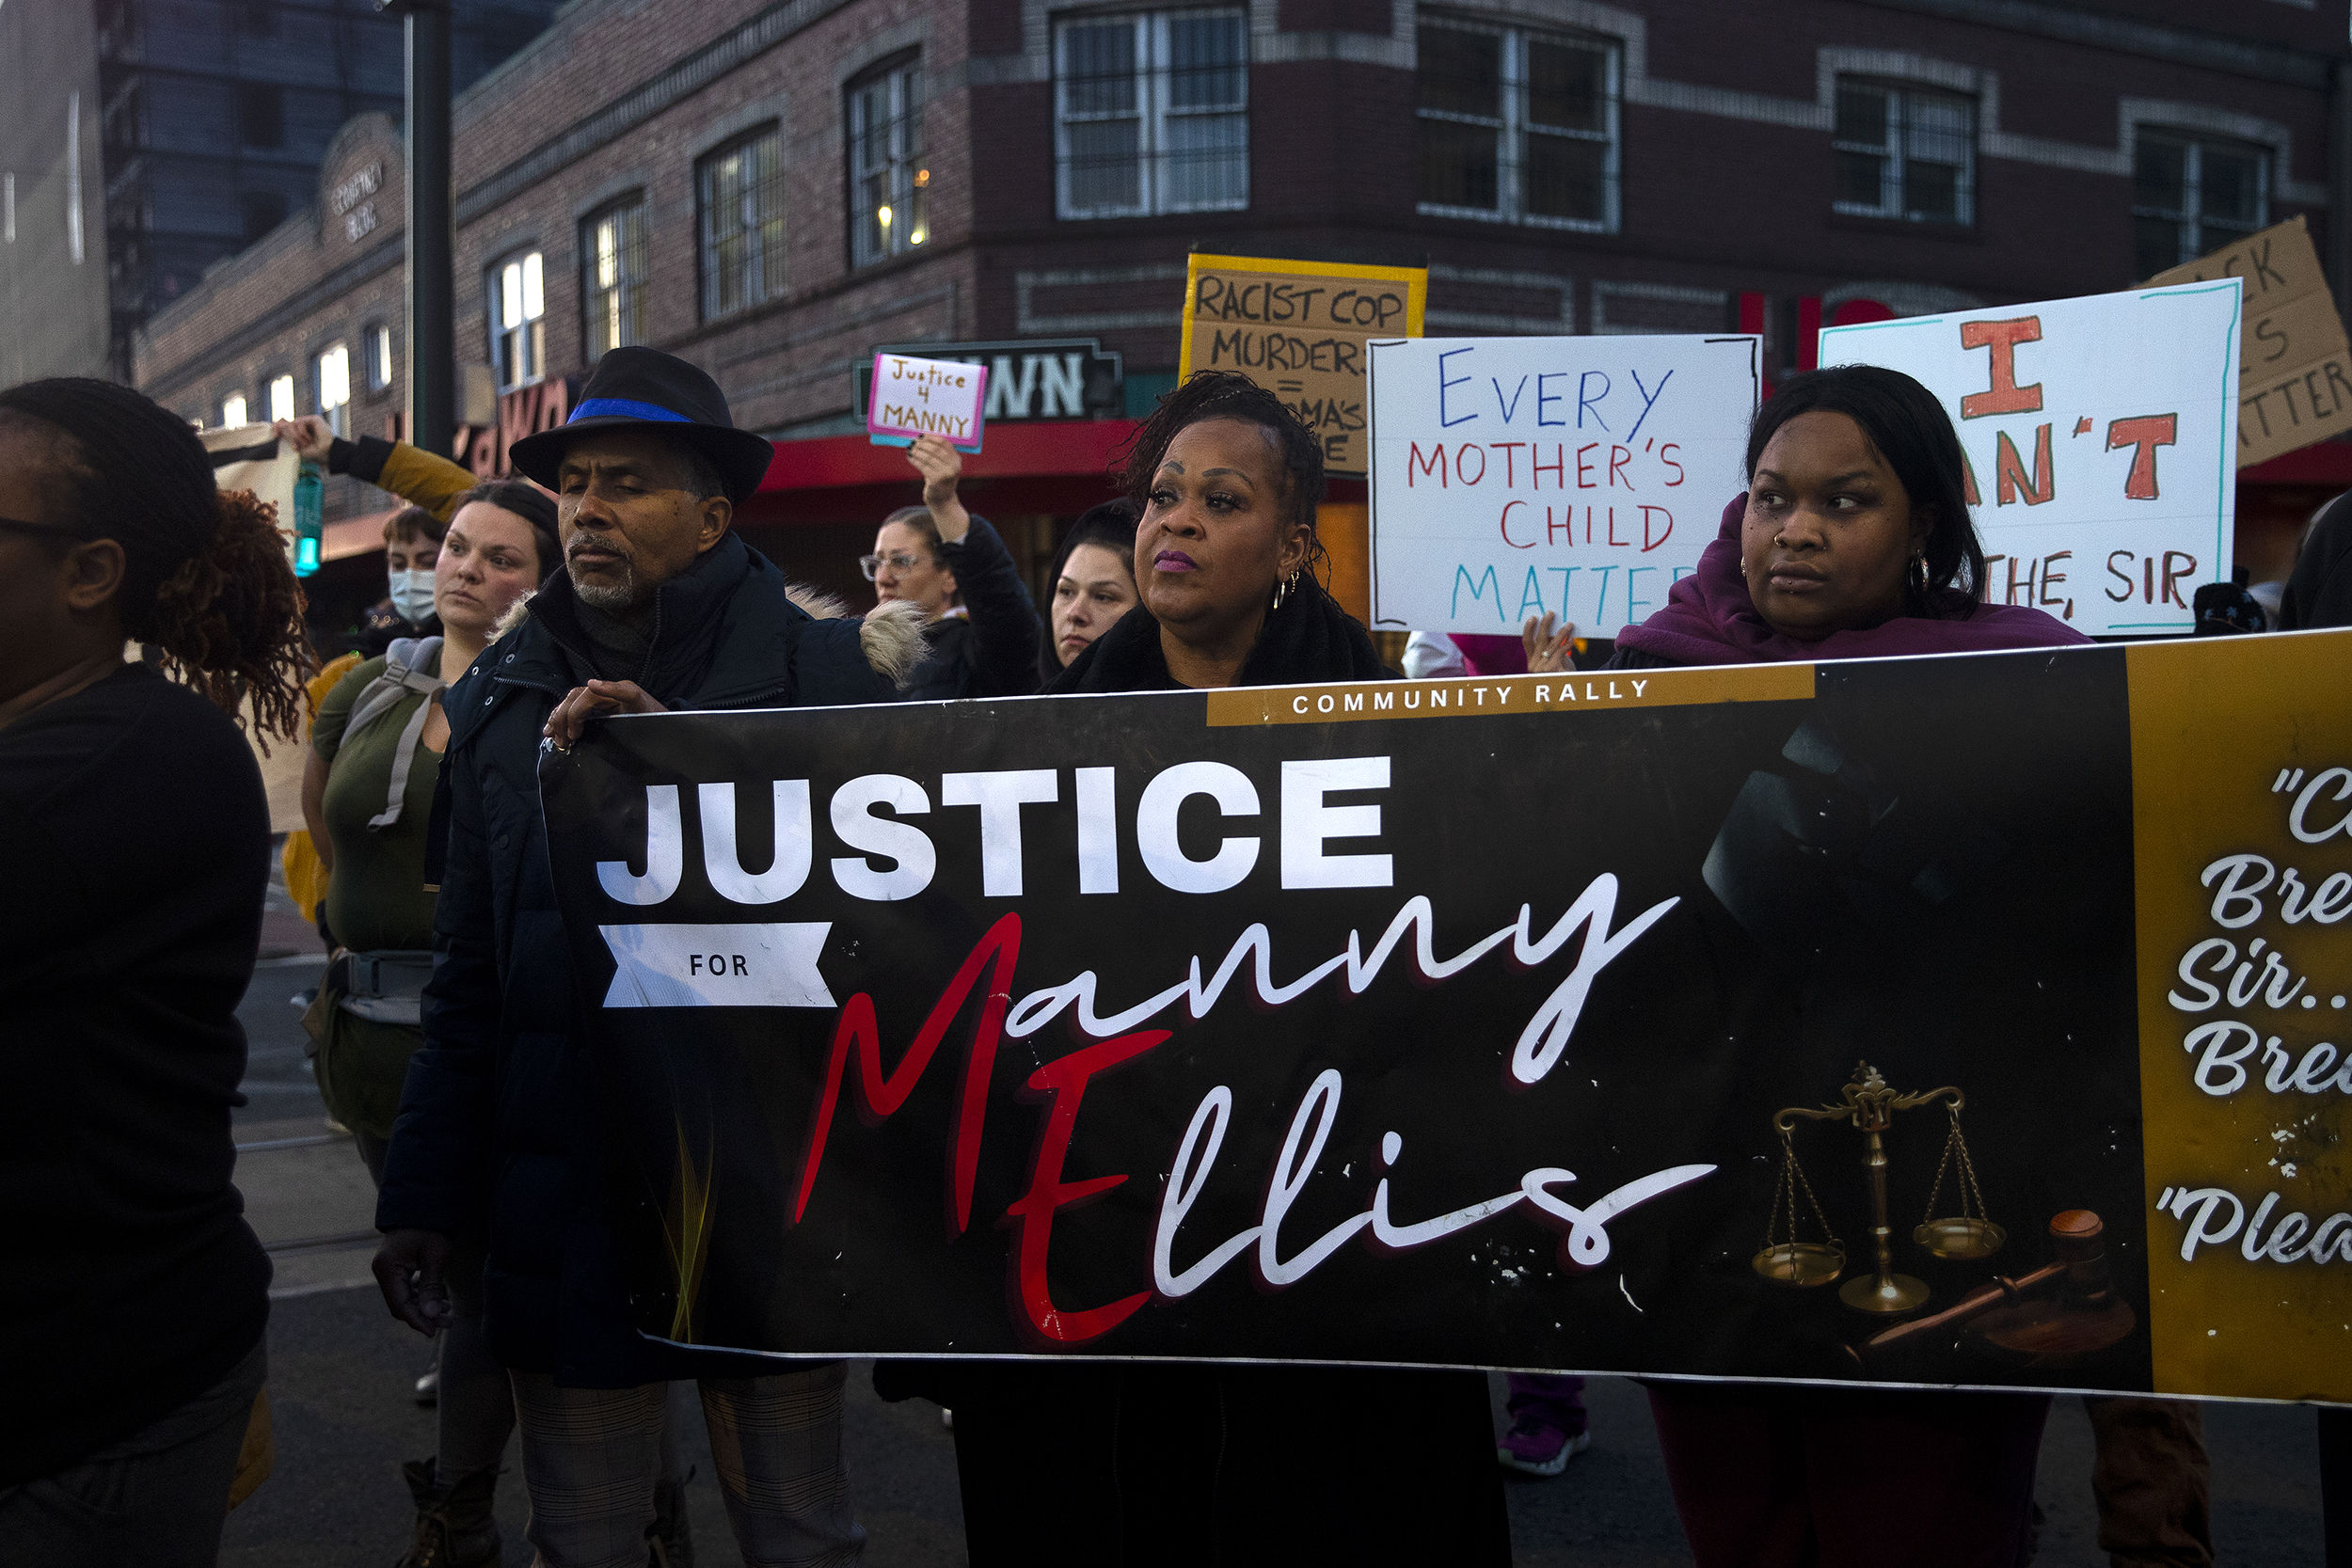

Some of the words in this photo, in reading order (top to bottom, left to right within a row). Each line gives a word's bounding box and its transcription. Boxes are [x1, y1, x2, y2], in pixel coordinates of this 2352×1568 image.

[1196, 276, 1325, 322] RACIST
[1329, 289, 1403, 328] COP
[892, 358, 966, 388] Justice
[1211, 328, 1367, 376] MURDER
[1960, 314, 2043, 420] I
[882, 404, 969, 436] MANNY
[918, 386, 930, 404] 4
[1438, 347, 1674, 443] EVERY
[2237, 361, 2352, 448] TTER
[1408, 437, 1685, 492] MOTHER'S
[1958, 412, 2178, 507] N'T
[1500, 500, 1674, 553] CHILD
[1980, 549, 2074, 621] THE,
[2105, 549, 2198, 610] SIR
[1293, 686, 1512, 715] COMMUNITY
[1534, 679, 1648, 704] RALLY
[596, 755, 1394, 906] JUSTICE
[2271, 767, 2352, 844] "C
[689, 953, 750, 977] FOR
[793, 871, 1681, 1236] Manny
[1005, 1027, 1719, 1342] Ellis
